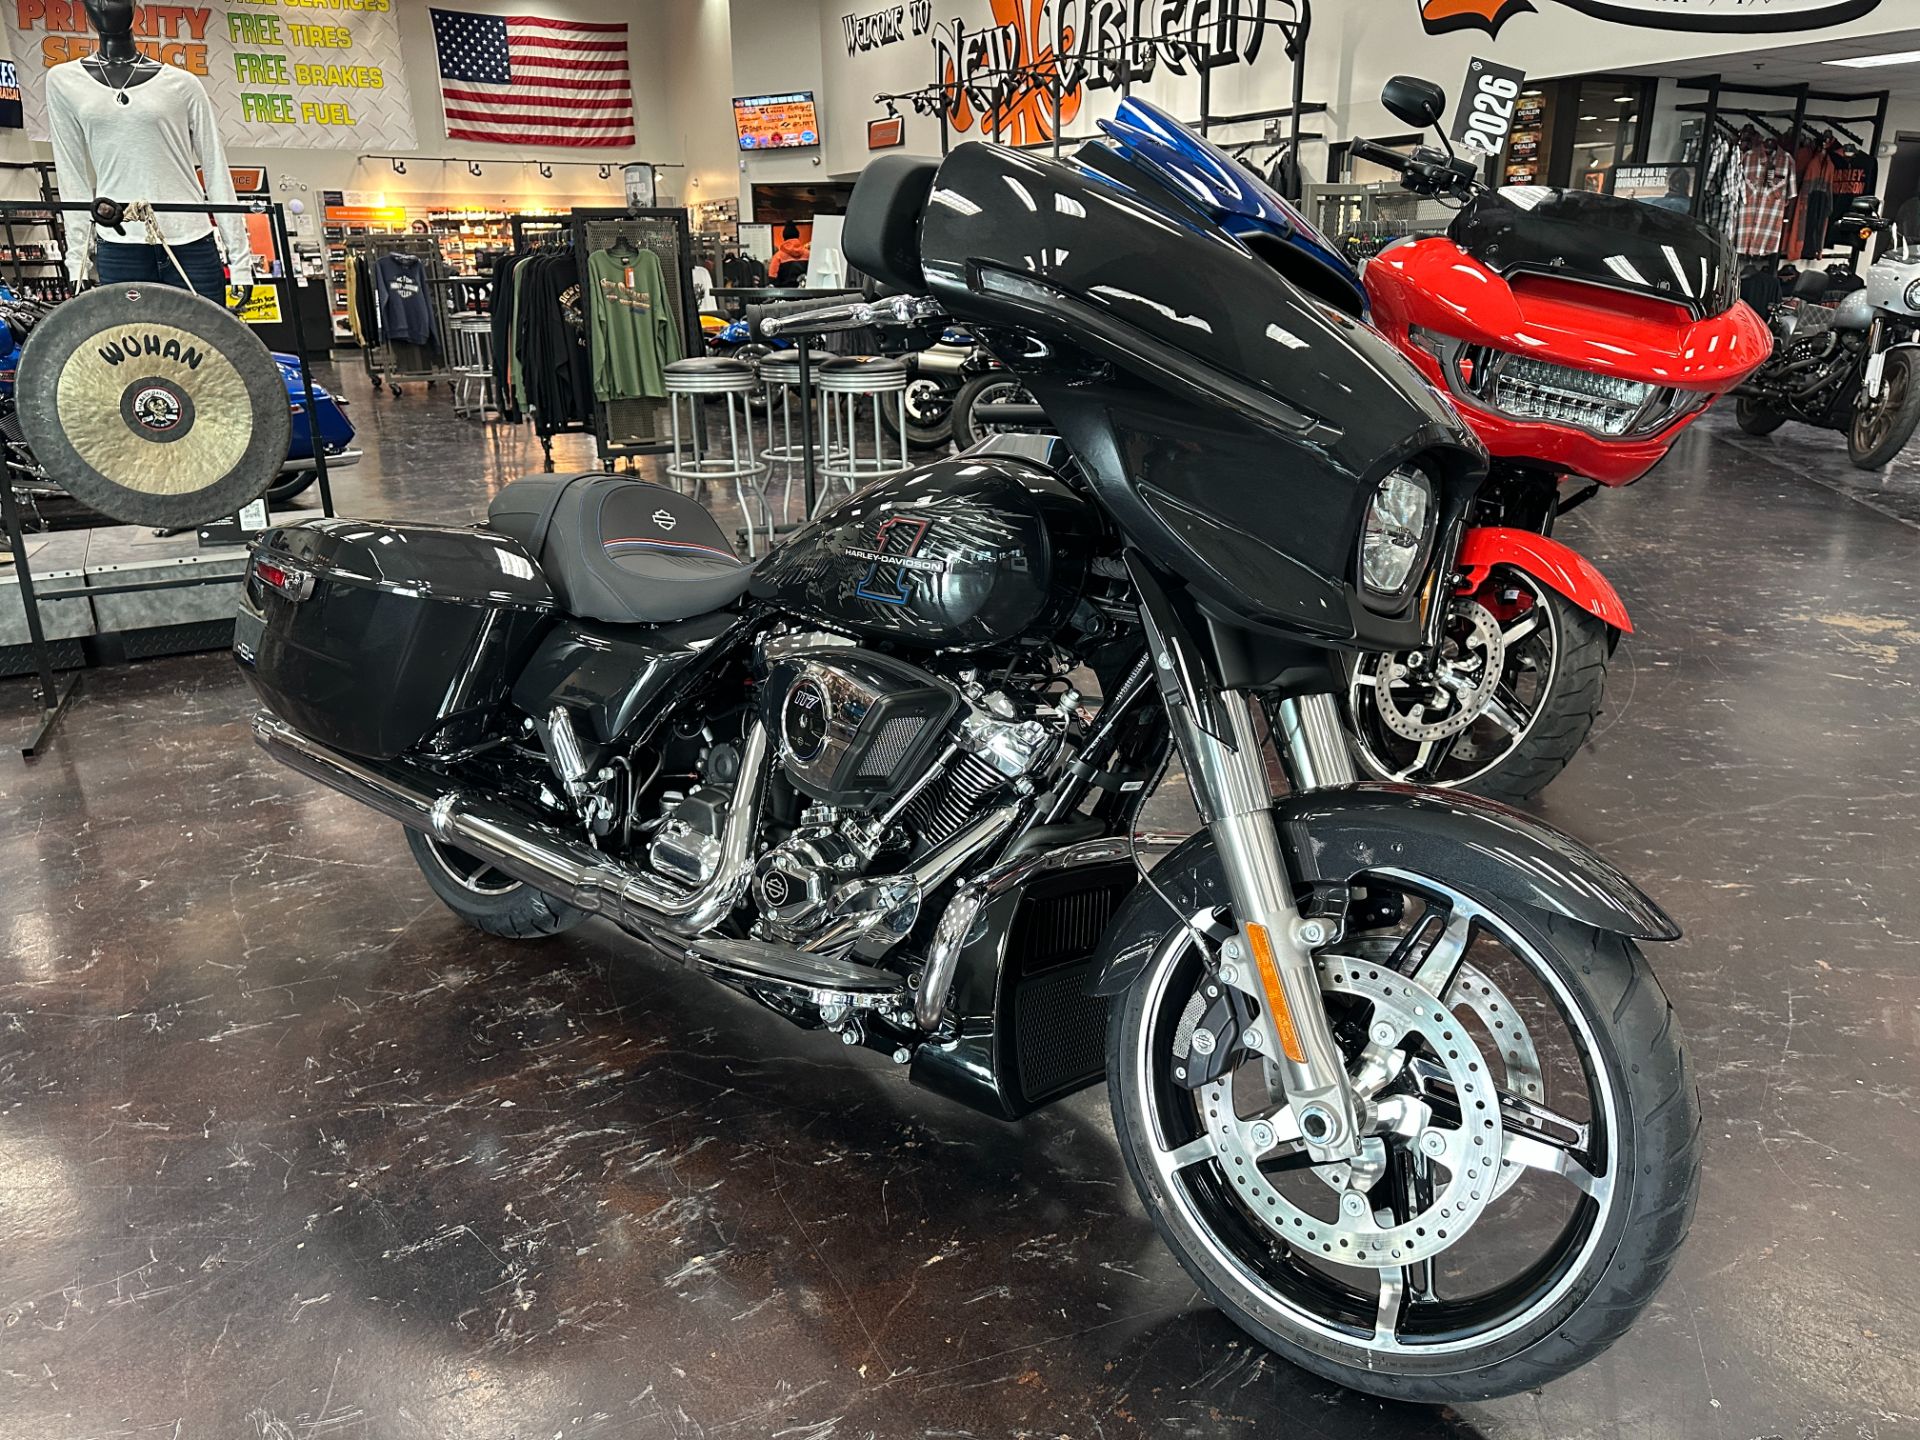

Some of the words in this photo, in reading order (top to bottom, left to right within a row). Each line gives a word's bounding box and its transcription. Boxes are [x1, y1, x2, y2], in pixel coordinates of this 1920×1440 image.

[17, 0, 211, 39] PRIITY
[227, 12, 284, 46] FREE
[287, 24, 353, 49] TIRES
[42, 36, 209, 76] SEICE
[234, 53, 290, 86] FREE
[294, 63, 384, 89] BRAKES
[240, 93, 296, 124] FREE
[301, 103, 356, 126] FUEL
[1464, 75, 1518, 155] 2026
[1518, 109, 1540, 117] DEALER
[1616, 168, 1631, 178] SUIT
[1641, 167, 1655, 177] FOR
[1655, 167, 1668, 177] THE
[99, 335, 204, 370] WUHAN
[845, 548, 943, 572] HARLEY-DAVIDSON
[794, 690, 820, 710] 117
